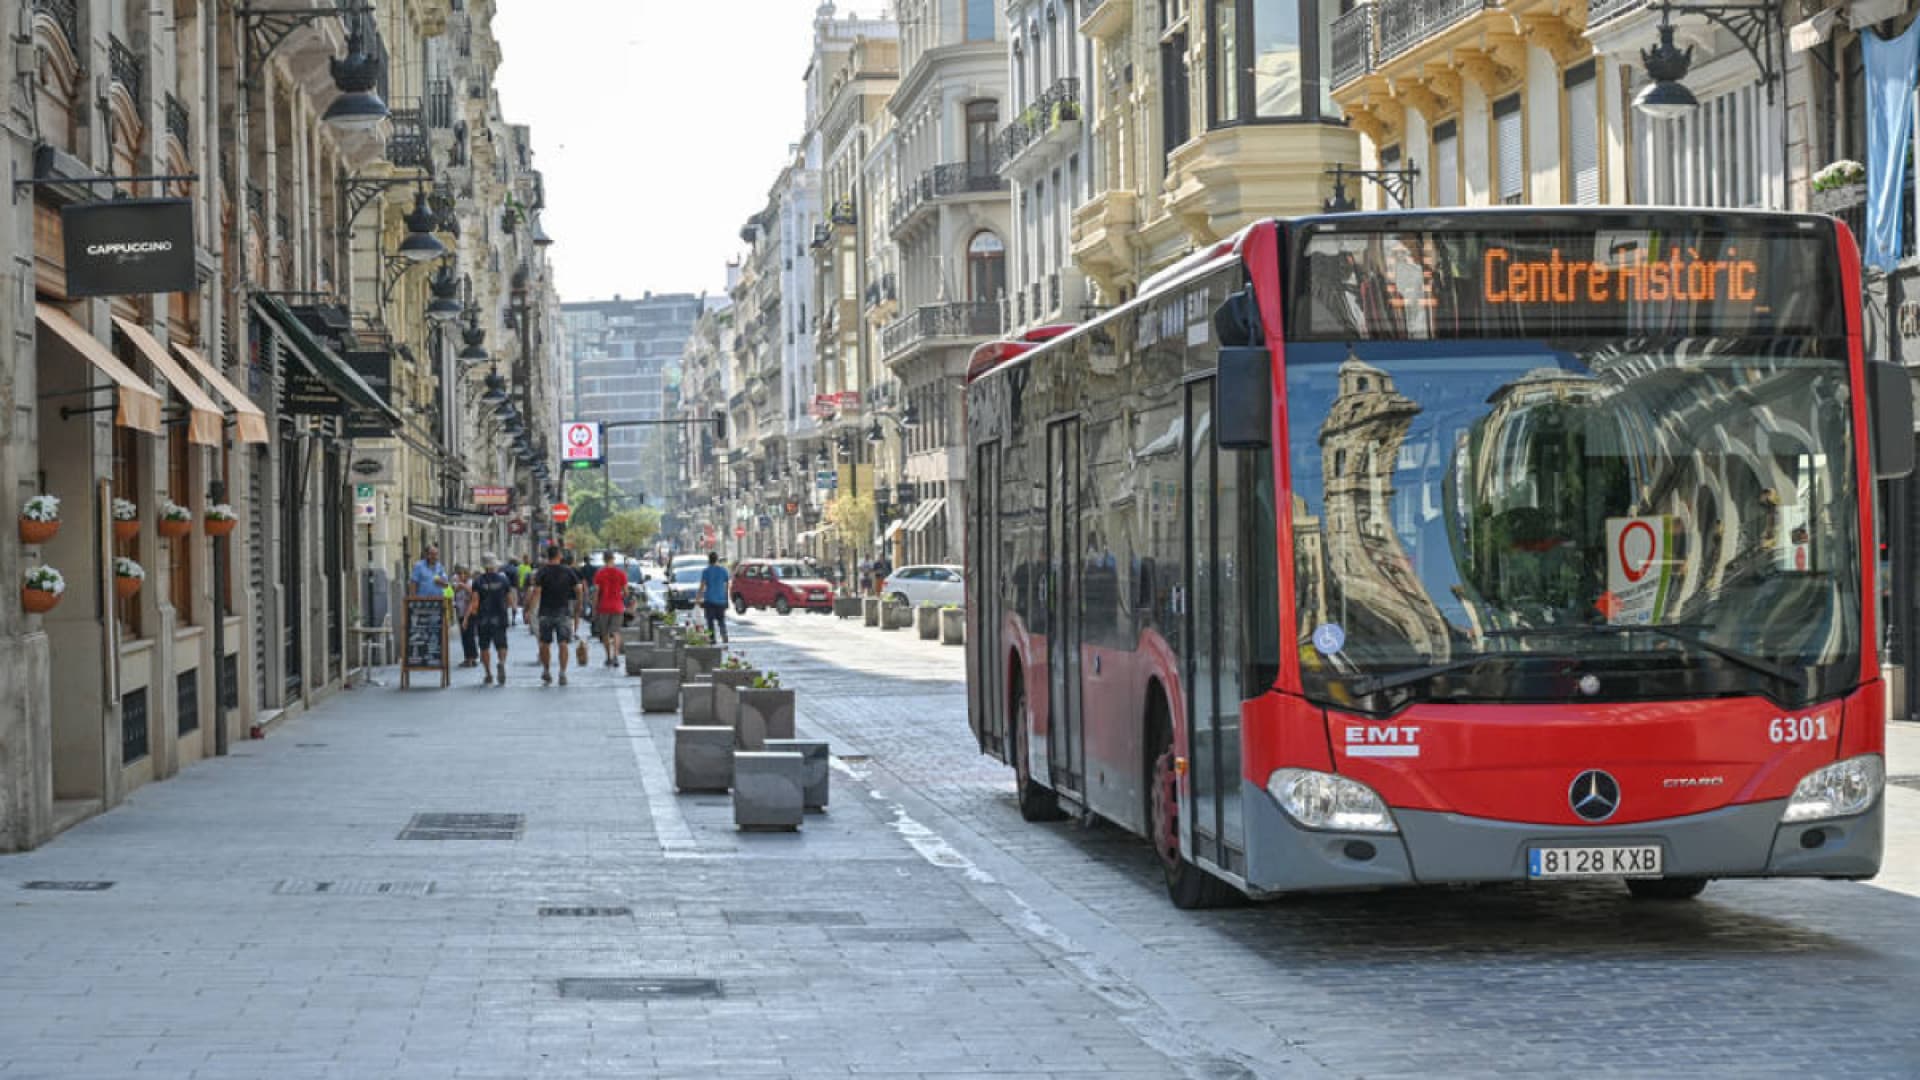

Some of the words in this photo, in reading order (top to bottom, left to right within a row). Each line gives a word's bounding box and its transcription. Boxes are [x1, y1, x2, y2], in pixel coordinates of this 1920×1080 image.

[87, 241, 172, 255] CAPPUCCINO
[1483, 247, 1608, 302] Centre
[1618, 246, 1757, 302] Històric
[1345, 726, 1421, 743] EMT
[1769, 716, 1828, 743] 6301
[1545, 850, 1604, 872] 8128
[1612, 849, 1656, 871] KXB
